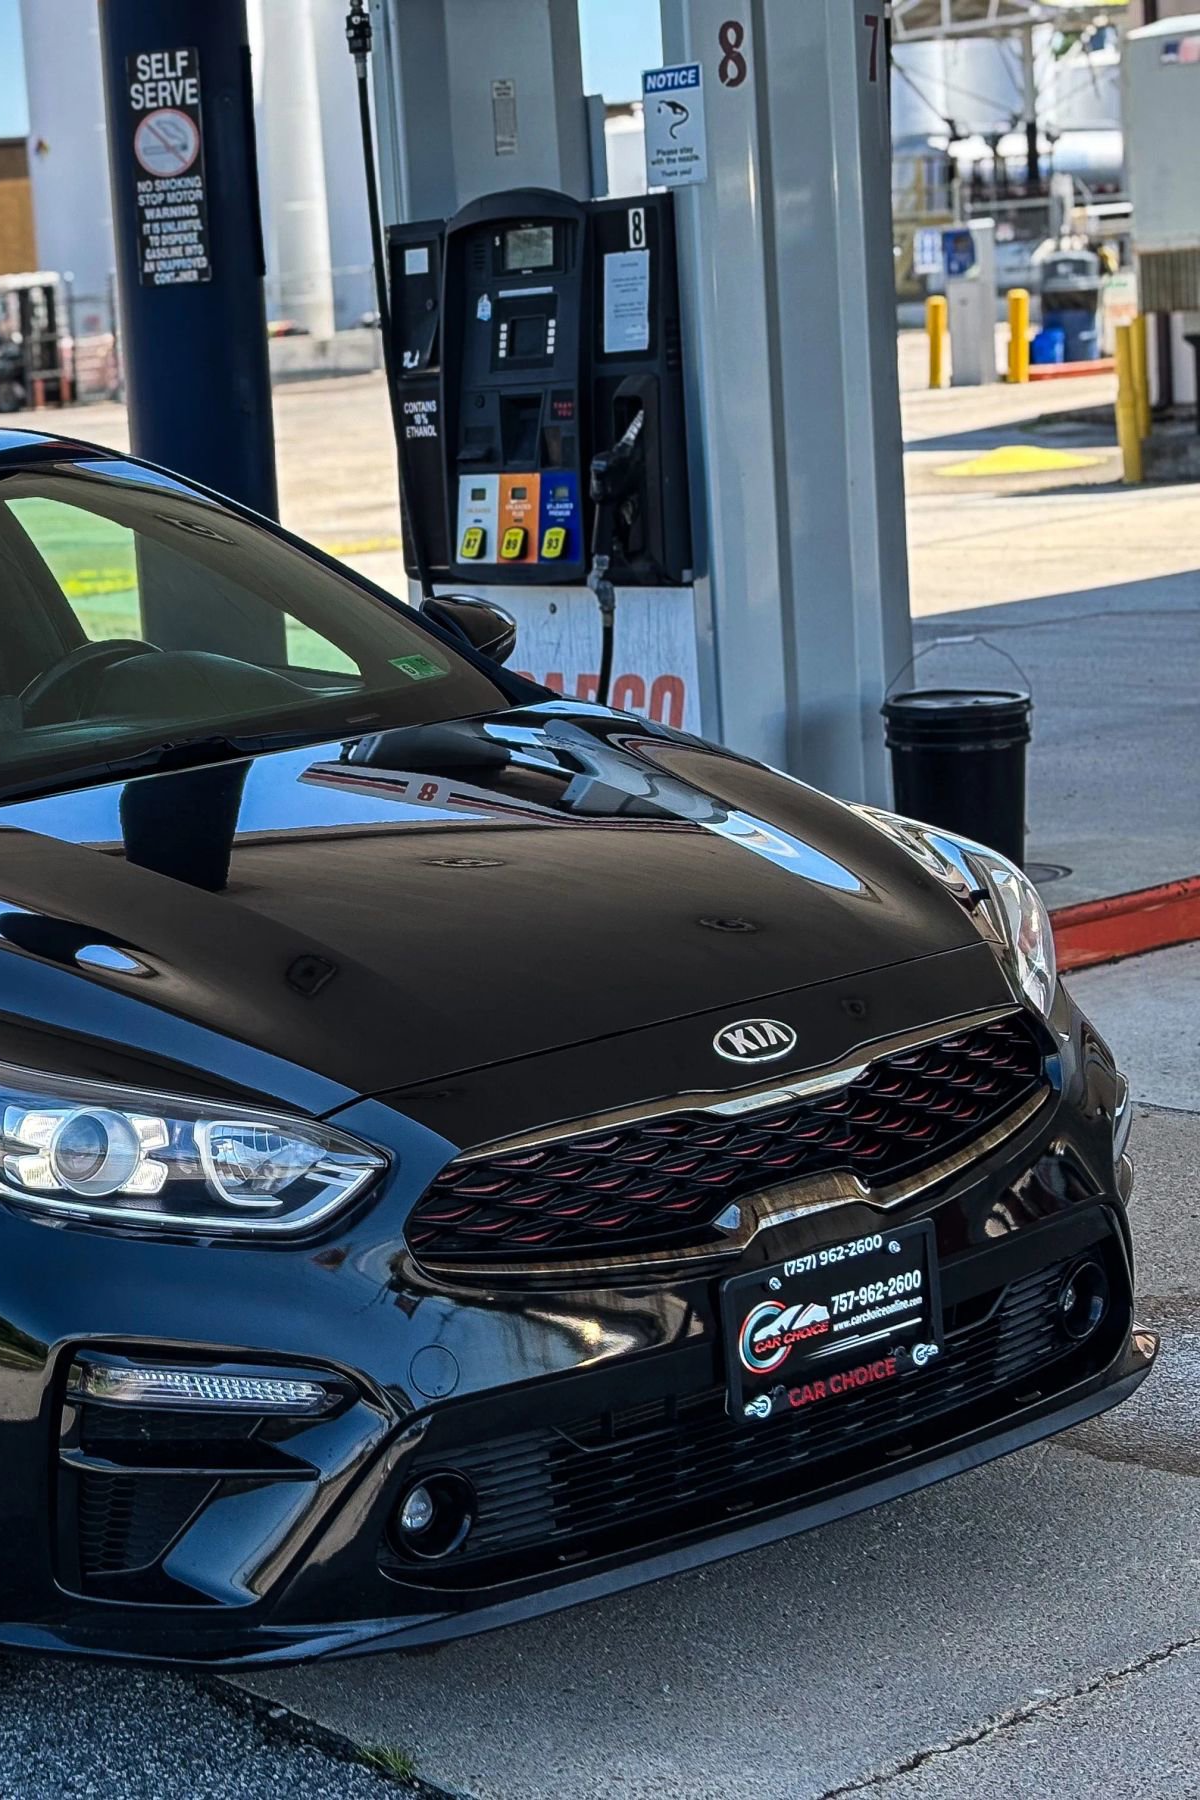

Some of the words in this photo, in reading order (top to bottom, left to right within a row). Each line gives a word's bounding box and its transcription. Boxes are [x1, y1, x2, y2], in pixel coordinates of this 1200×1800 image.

[718, 20, 747, 88] 8
[864, 15, 879, 82] 7
[136, 51, 189, 81] SELF
[646, 69, 697, 91] NOTICE
[130, 78, 199, 110] SERVE
[137, 180, 153, 193] NO
[154, 175, 202, 192] SMOKING
[138, 192, 165, 206] STOP
[167, 189, 203, 203] MOTOR
[144, 204, 199, 220] WARNING
[632, 210, 643, 246] 8
[403, 400, 437, 414] CONTAINS
[406, 425, 438, 438] ETHANOL
[723, 1022, 790, 1055] KIA
[784, 1253, 817, 1277] (757)
[819, 1234, 883, 1266] 962-2600
[831, 1269, 922, 1315] 757-962-2600
[754, 1336, 781, 1353] CAR
[783, 1320, 830, 1344] CHOICE
[788, 1381, 825, 1407] CAR
[829, 1357, 897, 1393] CHOICE
